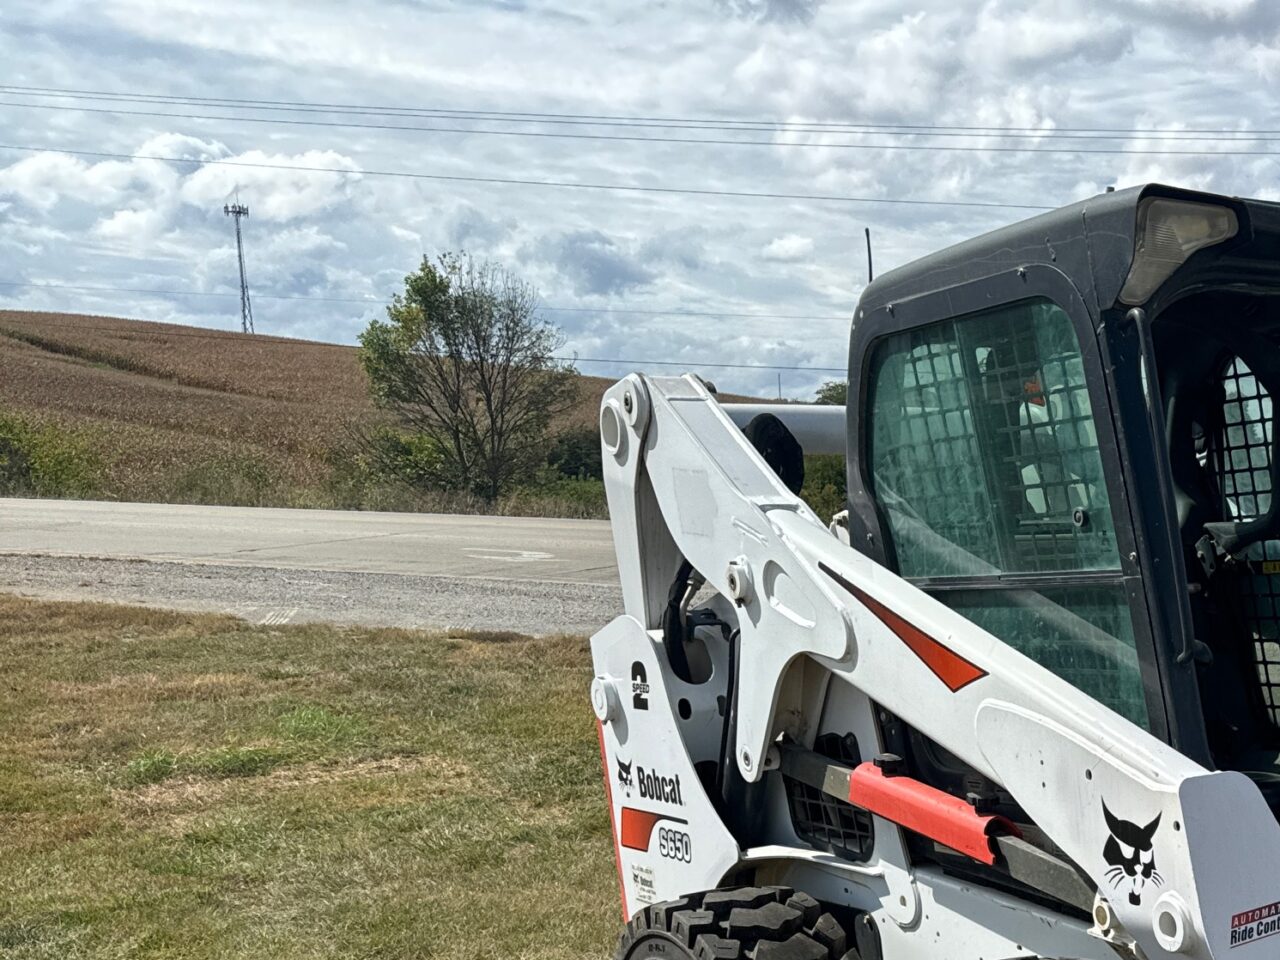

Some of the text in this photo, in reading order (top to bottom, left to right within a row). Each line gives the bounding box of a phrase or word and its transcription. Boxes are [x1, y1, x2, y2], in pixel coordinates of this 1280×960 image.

[631, 660, 649, 710] 2
[632, 682, 650, 693] SPEED
[637, 766, 683, 806] Bobcat
[659, 827, 692, 863] S650
[1230, 926, 1254, 945] Ride
